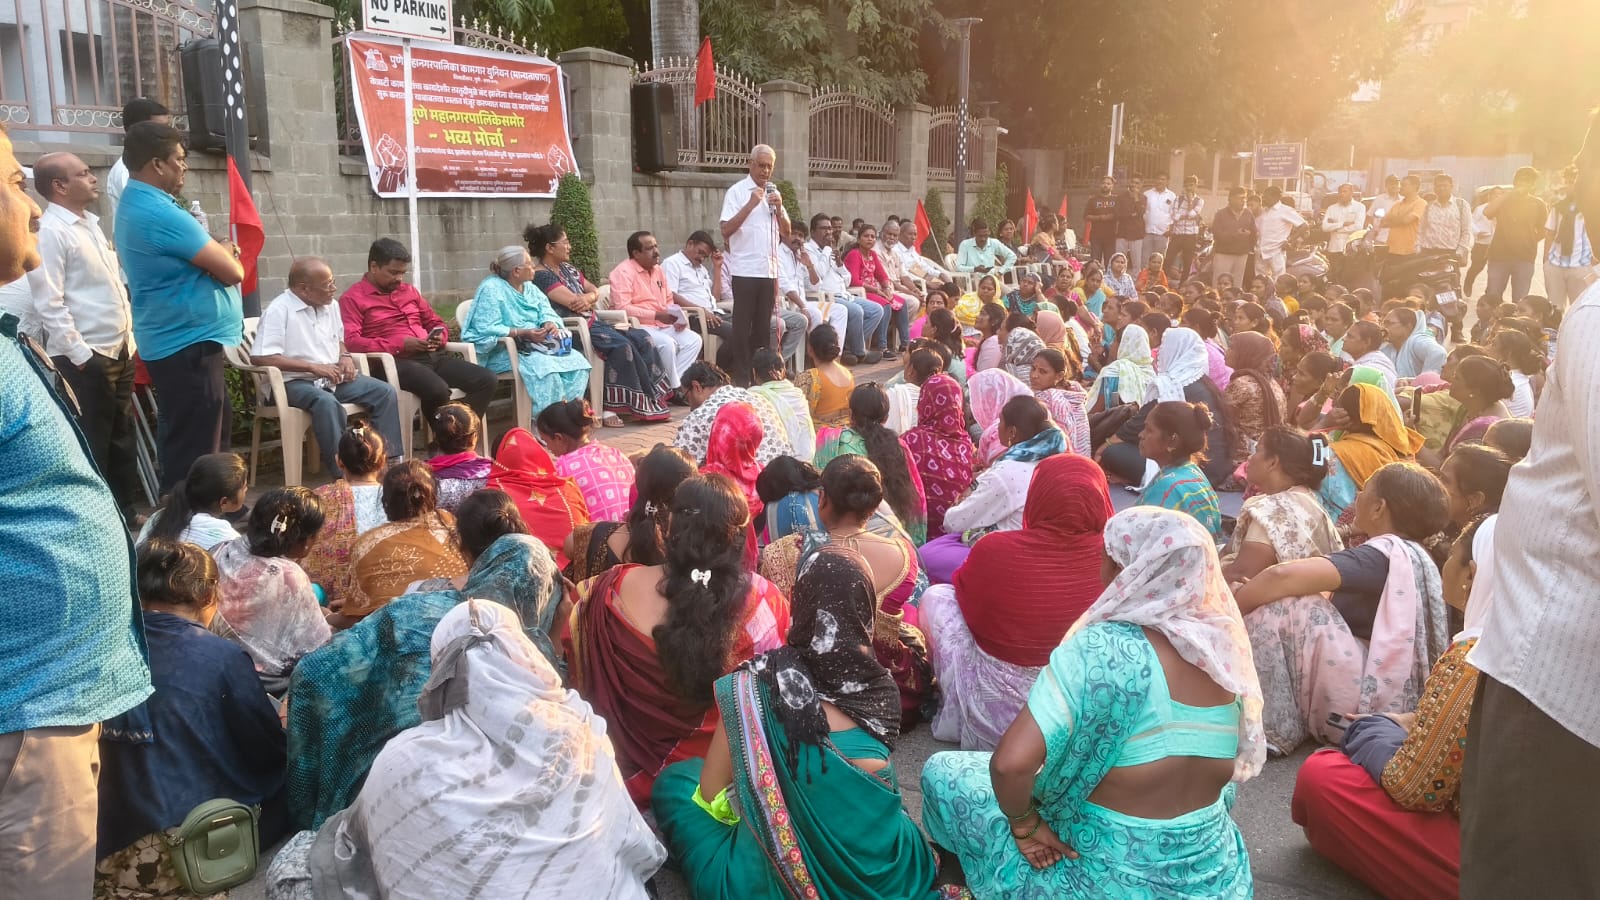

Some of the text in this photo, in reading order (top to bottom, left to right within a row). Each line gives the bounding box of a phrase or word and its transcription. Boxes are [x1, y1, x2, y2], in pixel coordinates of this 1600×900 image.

[371, 0, 446, 21] NO PARKING
[410, 58, 459, 73] हानगरपालिका
[429, 108, 525, 128] महानगरपालिकेसमोर
[443, 128, 473, 146] भव्य
[473, 126, 505, 148] मोर्चा
